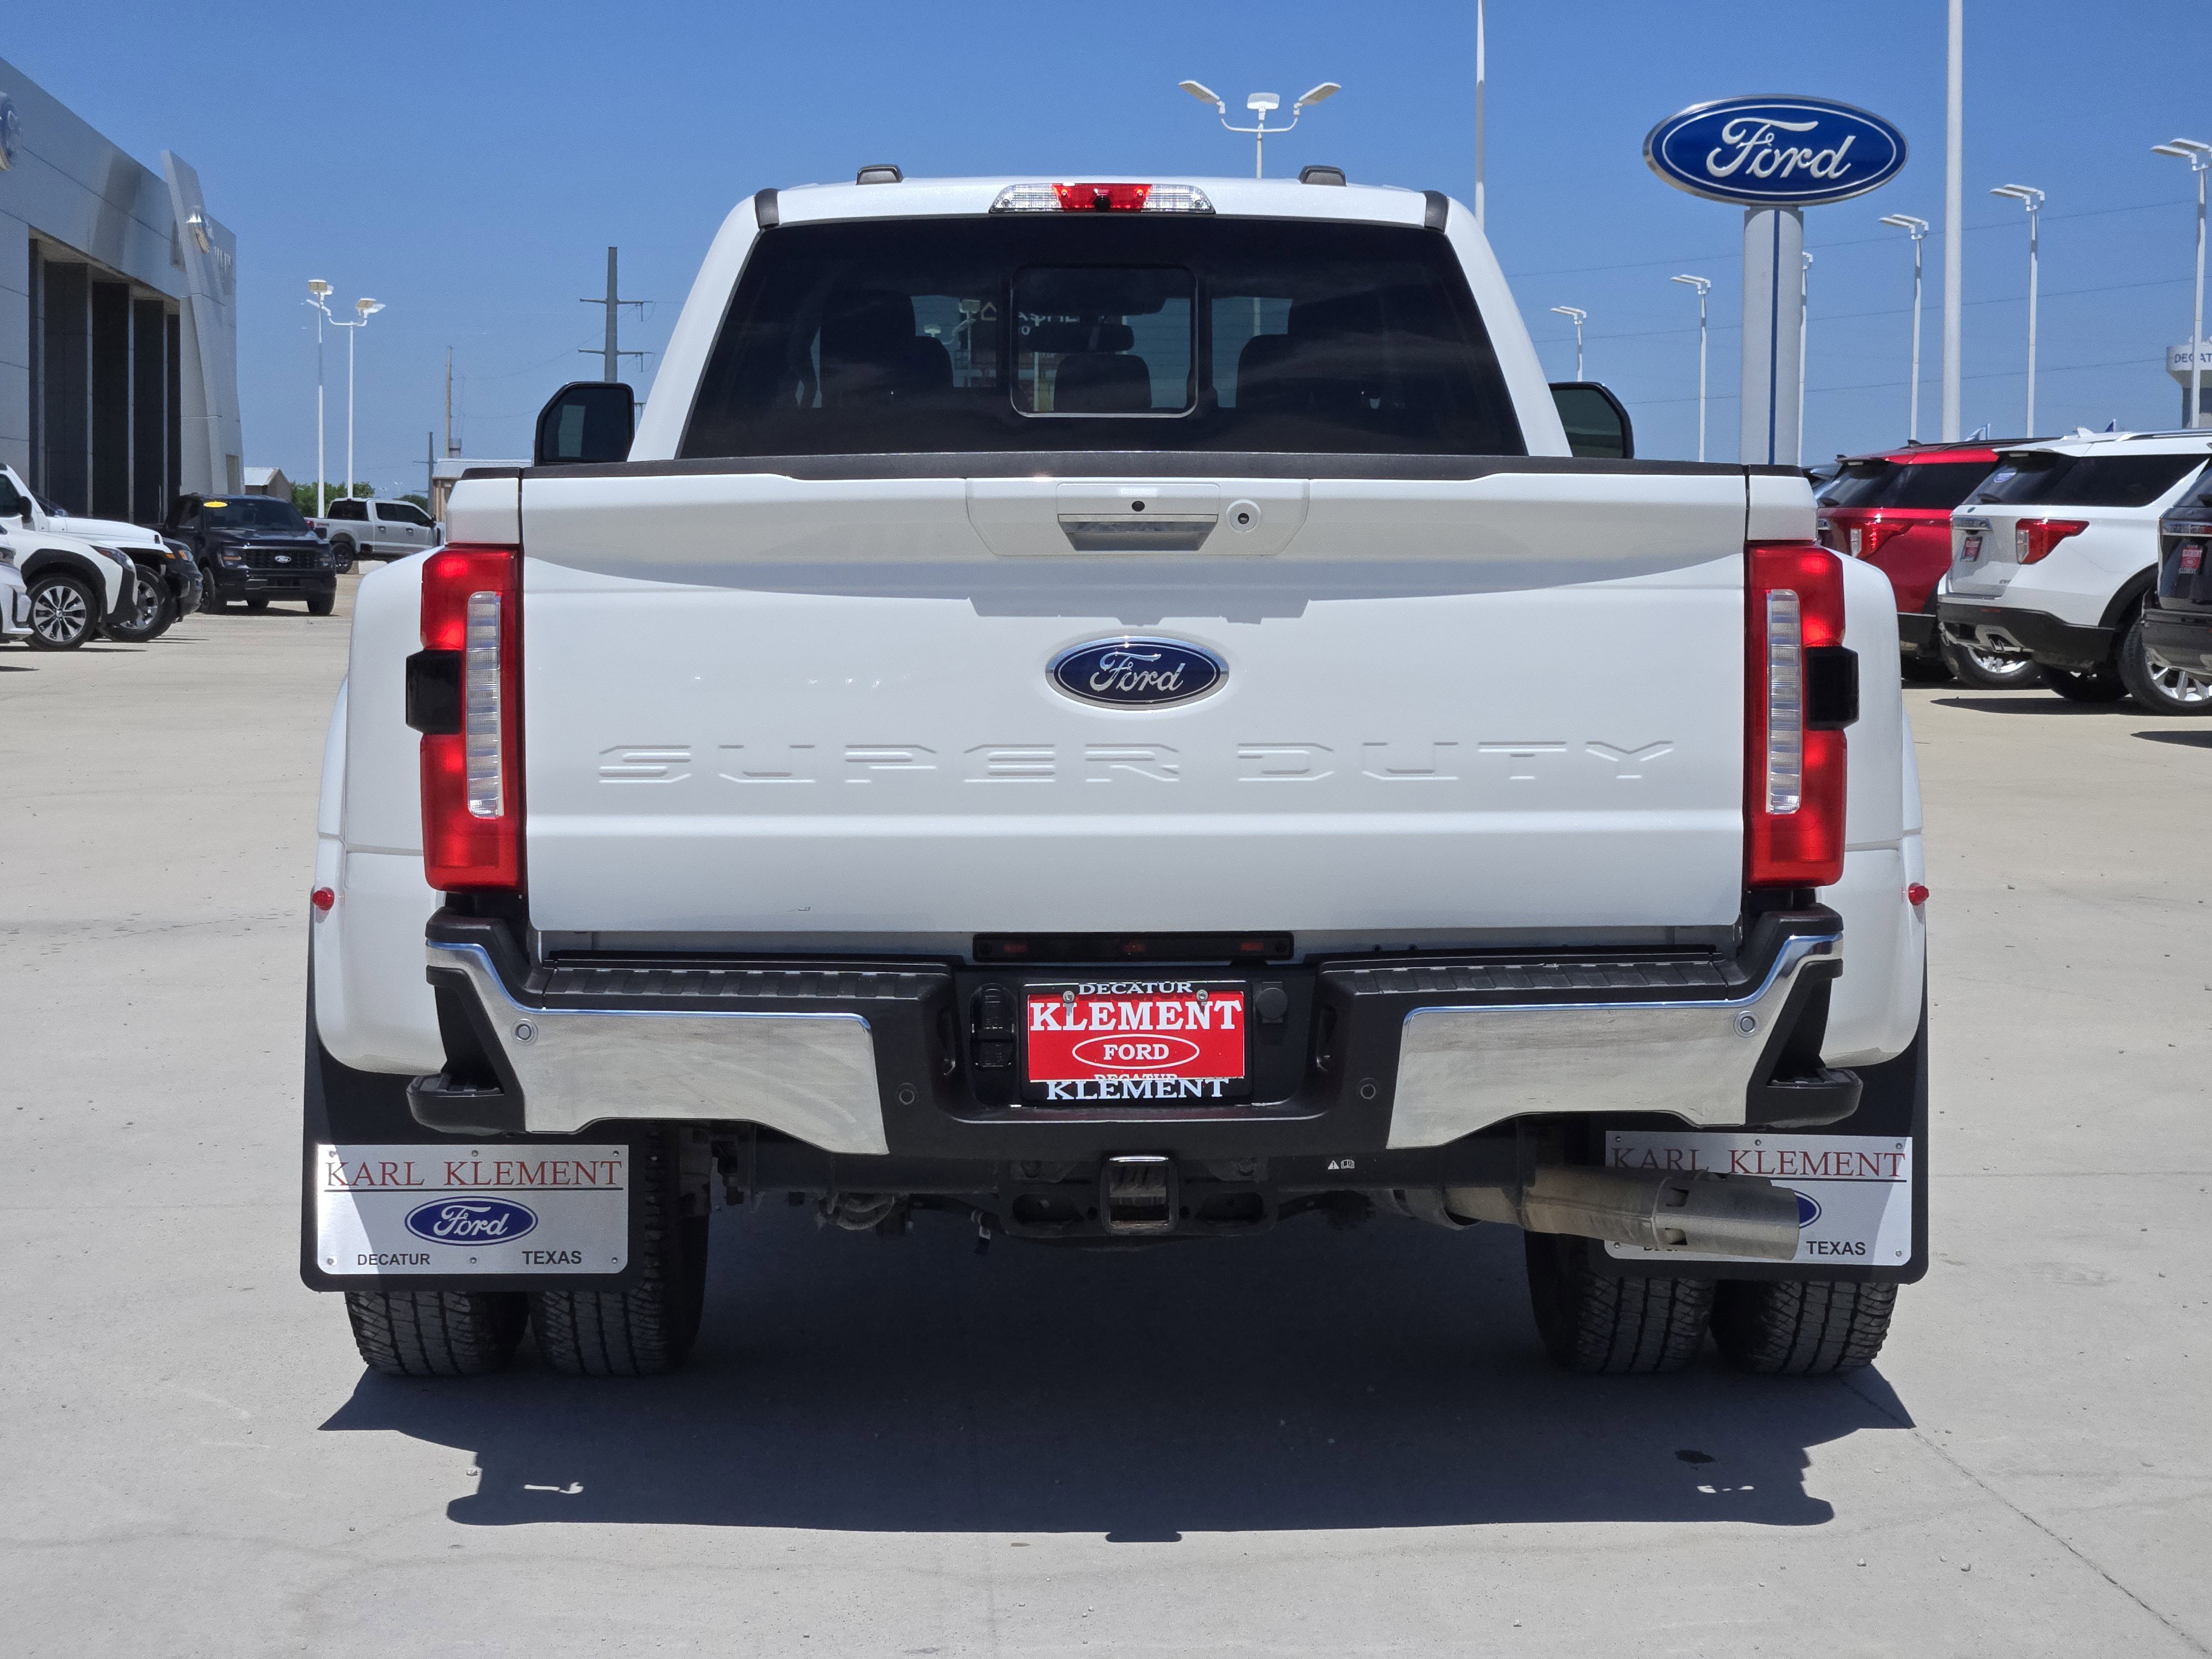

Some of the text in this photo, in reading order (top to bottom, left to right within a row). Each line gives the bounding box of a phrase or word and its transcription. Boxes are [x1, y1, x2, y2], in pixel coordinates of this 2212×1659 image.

[1706, 117, 1856, 179] Ford
[1089, 651, 1186, 692] Ford
[599, 740, 1673, 784] SUPER DUTY
[1078, 982, 1193, 995] DECATUR
[1030, 1000, 1243, 1031] KLEMENT
[1103, 1044, 1170, 1061] FORD
[1046, 1079, 1229, 1100] KLEMENT
[326, 1161, 623, 1187] KARL KLEMENT
[1728, 1150, 1906, 1177] KLEMENT
[433, 1204, 510, 1236] Ford
[357, 1250, 582, 1266] DECATUR TEXAS
[1806, 1240, 1866, 1256] TEXAS
